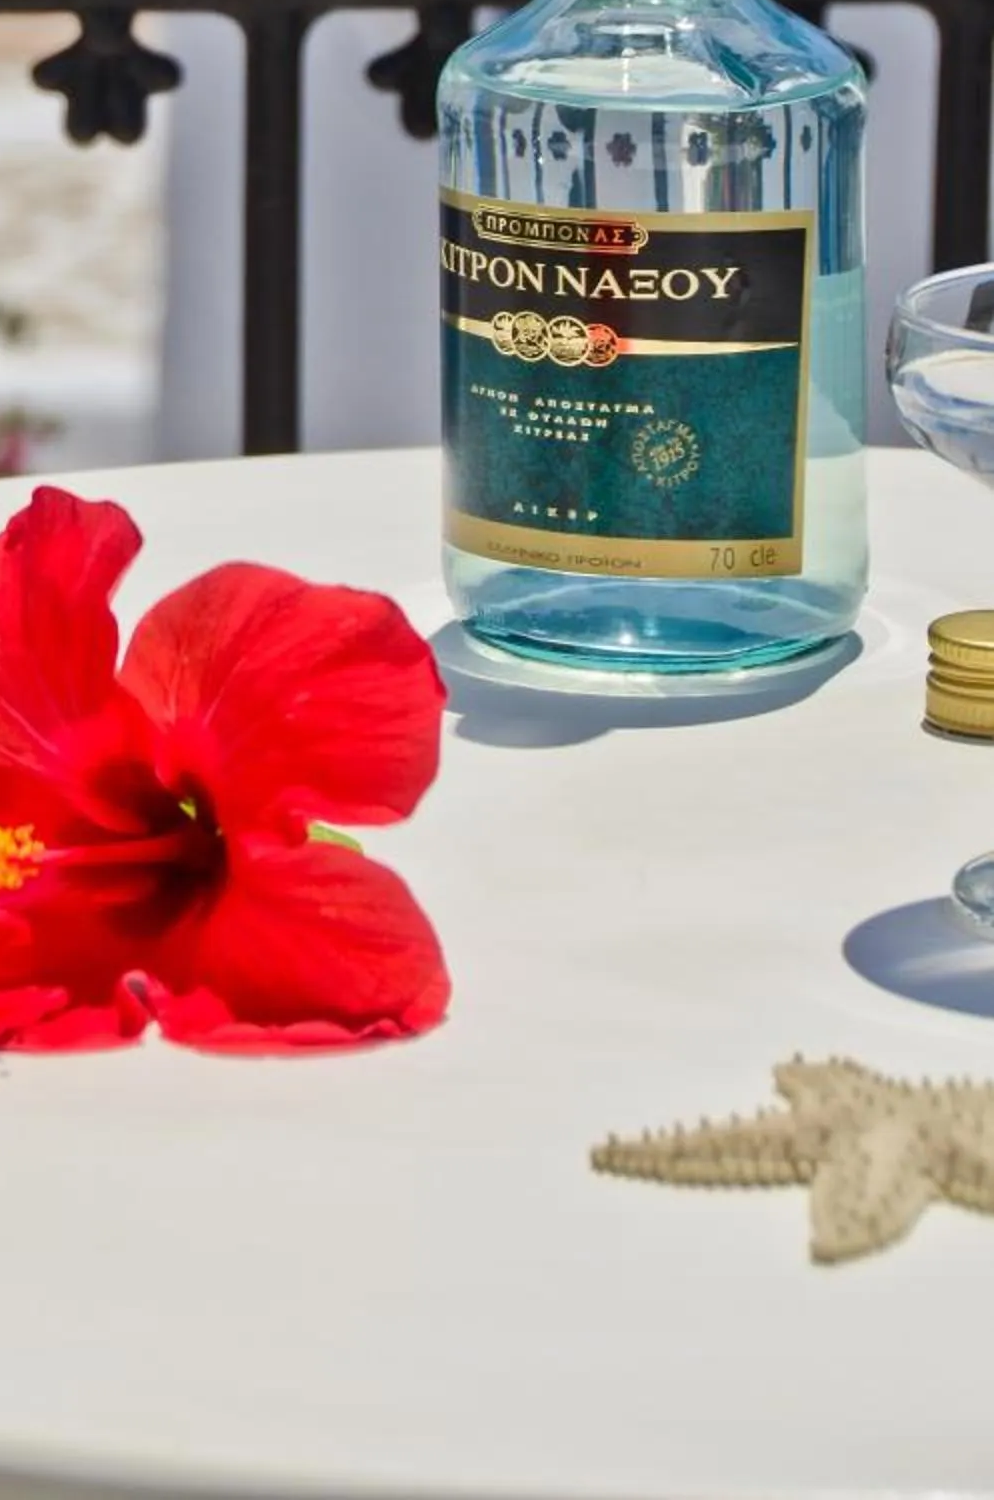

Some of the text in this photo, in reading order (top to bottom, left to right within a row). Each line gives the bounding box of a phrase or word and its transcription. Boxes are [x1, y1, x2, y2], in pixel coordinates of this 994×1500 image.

[485, 215, 626, 244] ΠΡΟΜΠΟΝΑΣ
[554, 265, 742, 300] ΝΑΞΟΥ
[710, 547, 735, 572] 70
